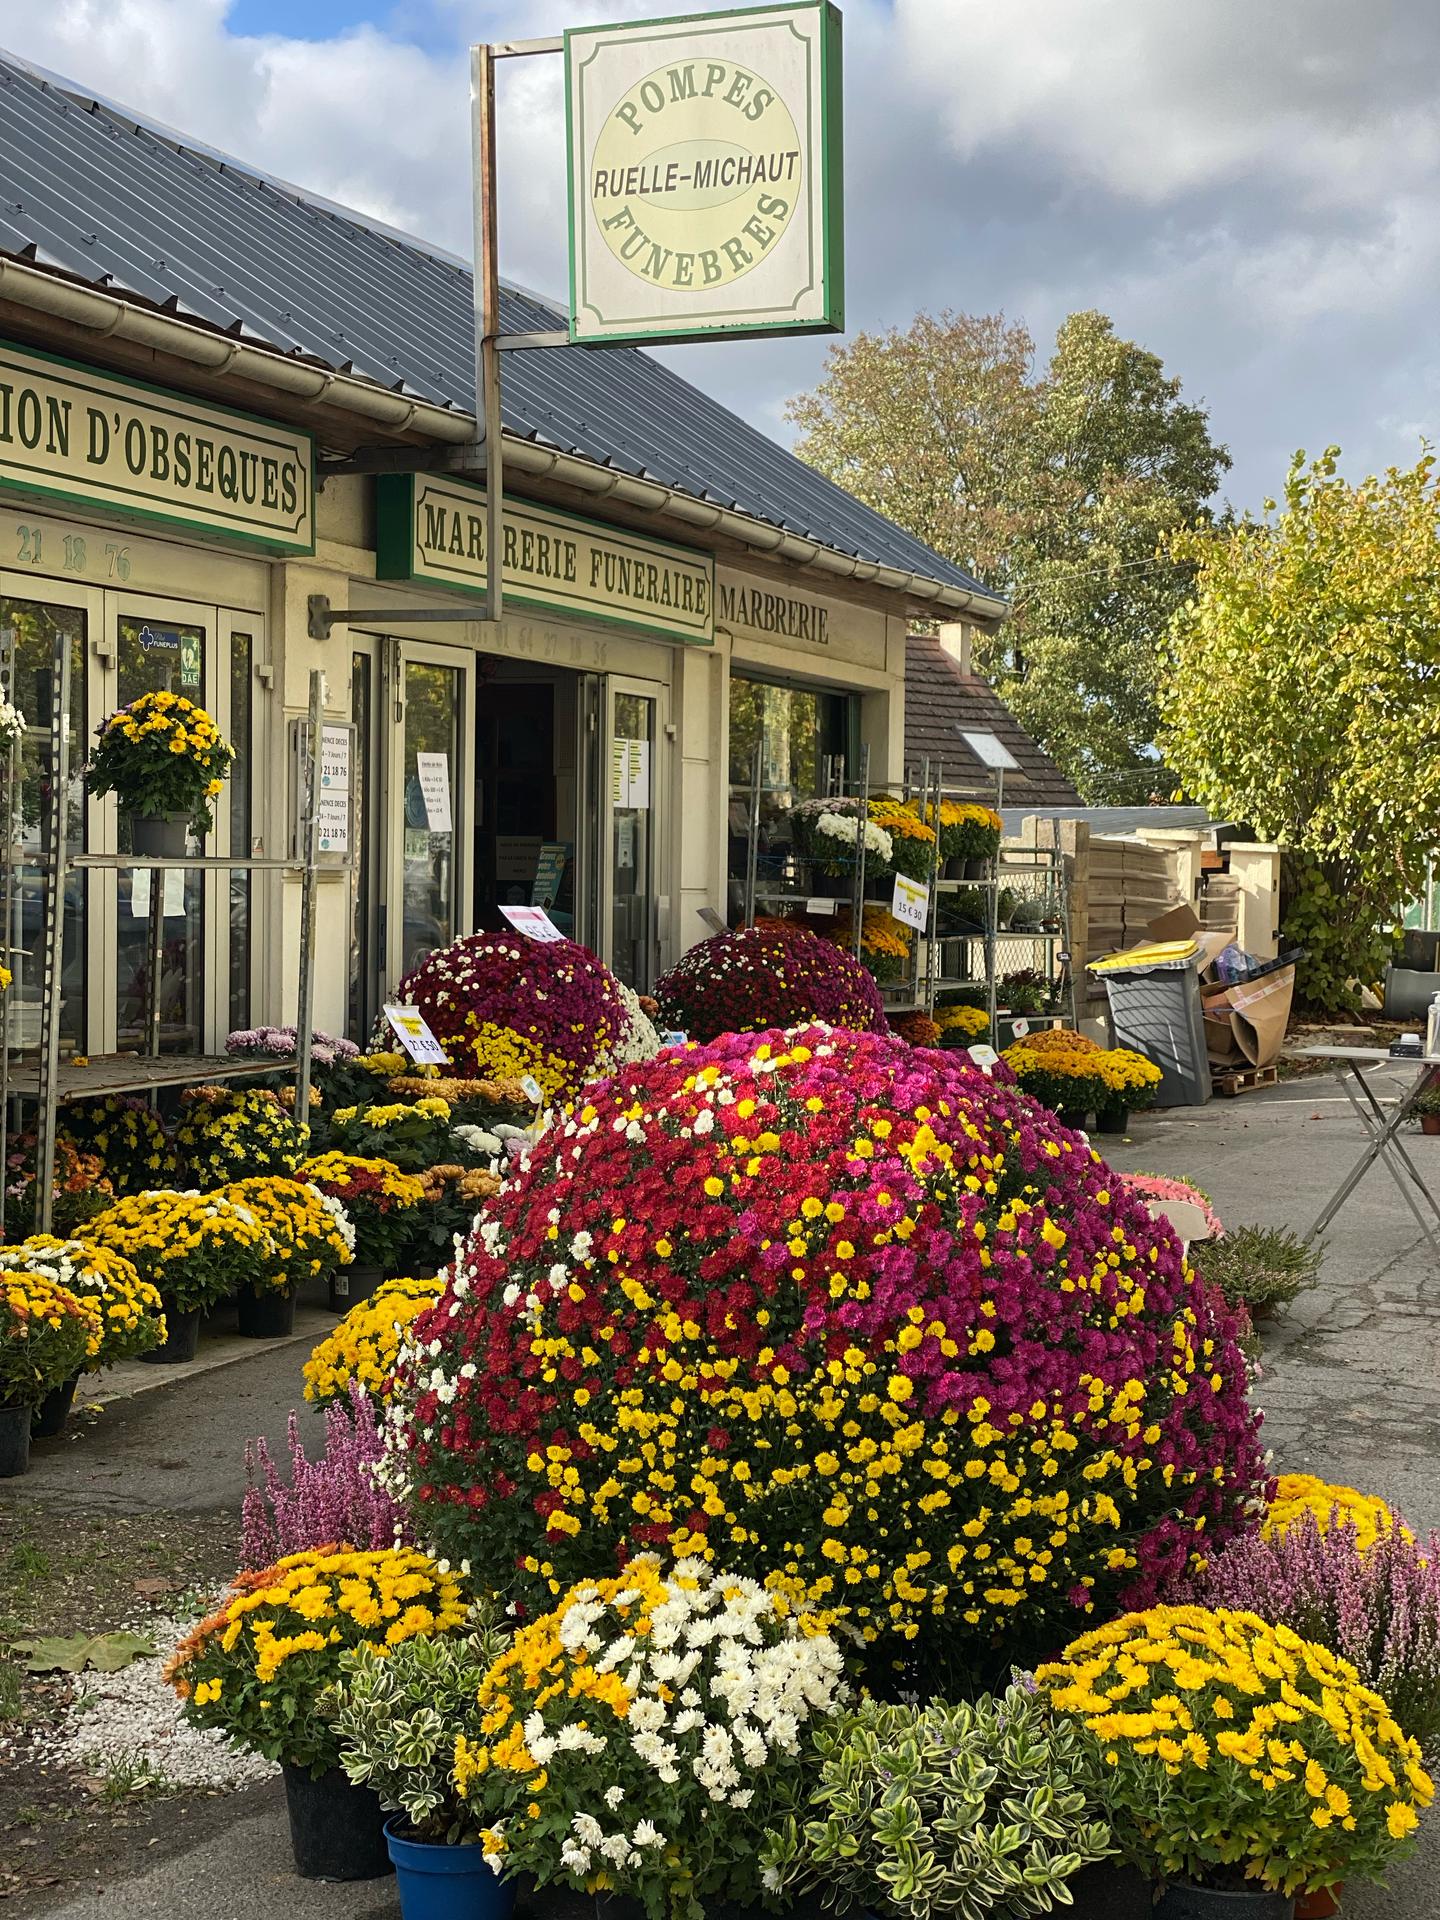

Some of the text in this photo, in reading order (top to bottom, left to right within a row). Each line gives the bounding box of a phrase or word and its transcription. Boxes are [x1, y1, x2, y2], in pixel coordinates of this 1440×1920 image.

[615, 63, 775, 135] POMPES
[593, 151, 799, 198] RUELLE-MICHAUT
[602, 193, 789, 286] FUNEBRES
[0, 382, 297, 514] ION D'OBSEQUES
[16, 525, 131, 581] 21 18 76
[425, 503, 706, 615] MARRERIE FUNERAIRE
[720, 583, 829, 645] MARBRERIE
[182, 673, 198, 684] DAE
[324, 765, 347, 777] 21 18 76
[323, 827, 330, 838] 21
[331, 828, 338, 838] 18
[339, 828, 347, 839] 76
[898, 902, 907, 914] 15
[914, 908, 922, 920] 30
